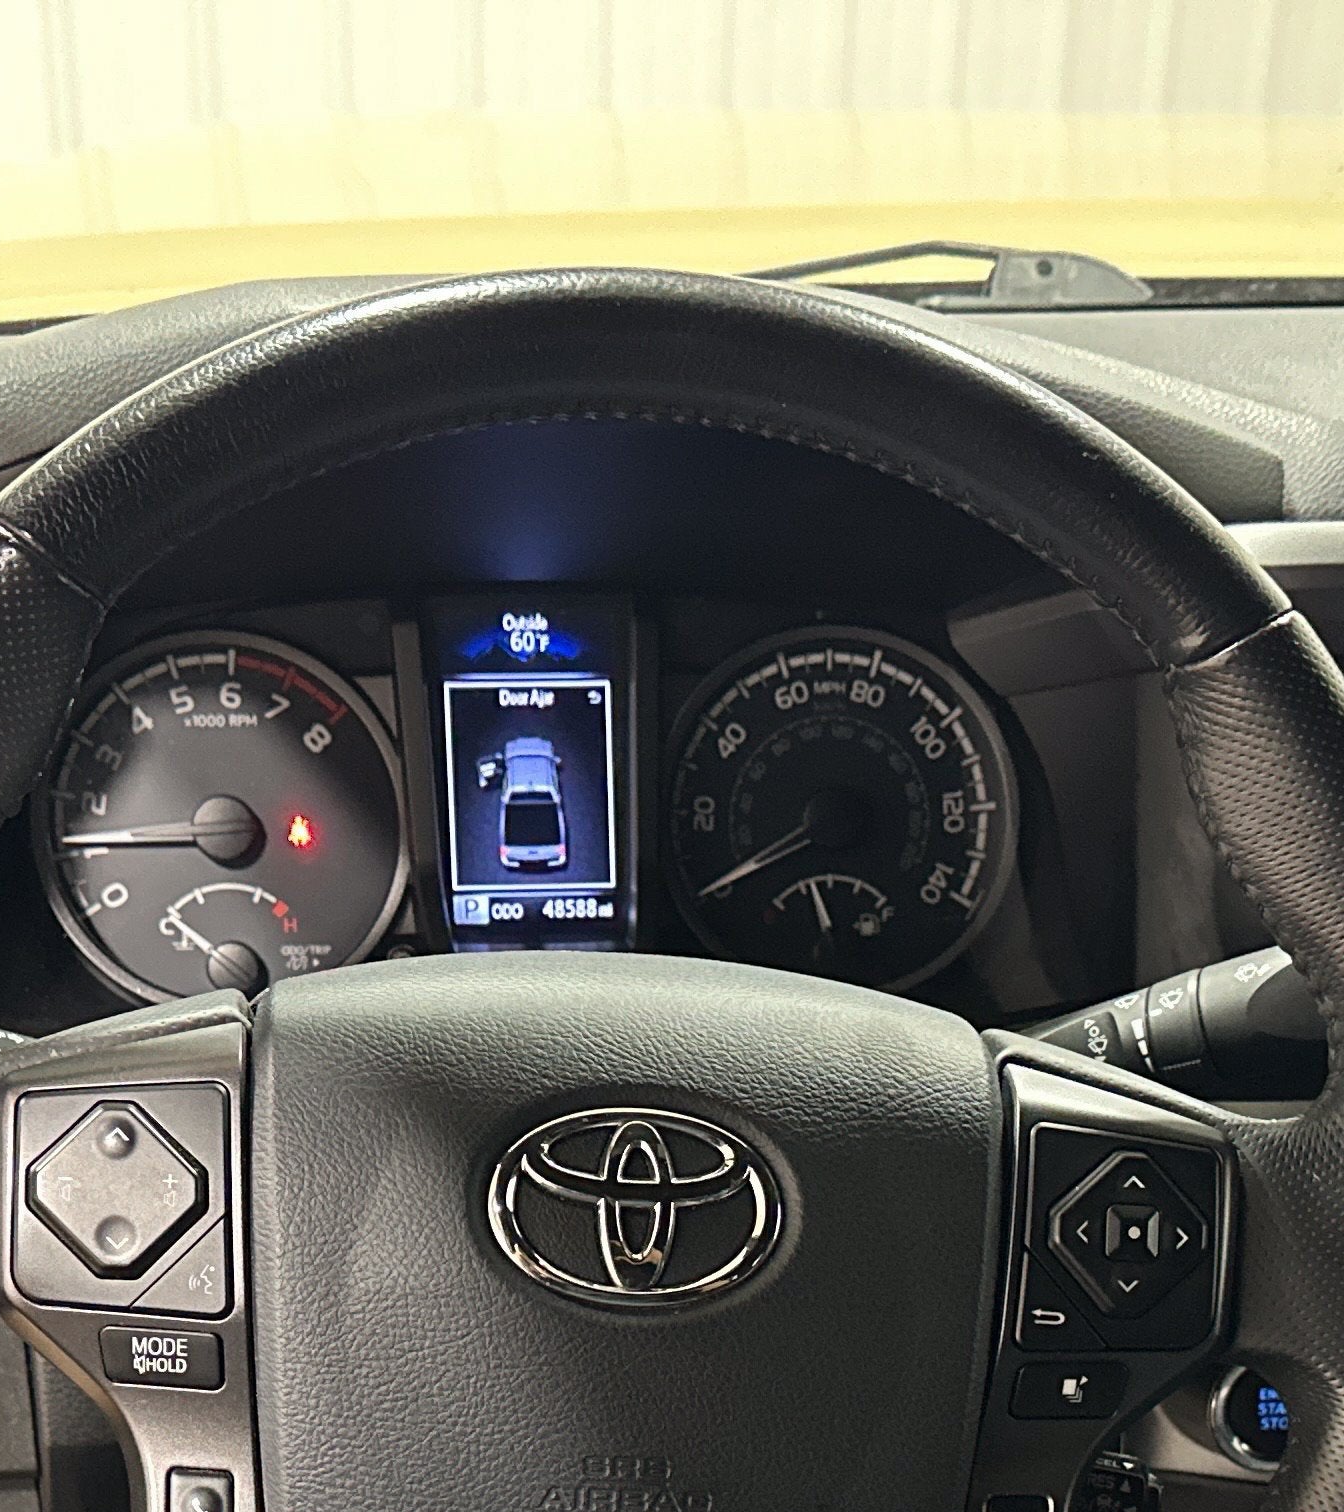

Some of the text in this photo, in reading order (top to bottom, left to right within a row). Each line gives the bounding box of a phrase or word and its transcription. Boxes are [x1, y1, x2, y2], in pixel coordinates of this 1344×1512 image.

[169, 685, 195, 715] 5
[218, 682, 242, 709] 6
[264, 694, 291, 720] 7
[499, 689, 529, 708] Door
[774, 681, 809, 709] 60
[849, 680, 886, 708] 80
[131, 706, 154, 736] 4
[229, 715, 258, 728] RPM
[303, 722, 333, 754] 8
[717, 722, 747, 759] 40
[910, 716, 946, 760] 100
[693, 796, 715, 832] 20
[942, 790, 964, 833] 120
[102, 882, 129, 909] 0
[920, 862, 954, 905] 140
[284, 918, 298, 933] H
[131, 1336, 189, 1357] MODE
[145, 1357, 188, 1374] HOLD
[1257, 1403, 1286, 1416] STA
[1260, 1417, 1289, 1431] STO
